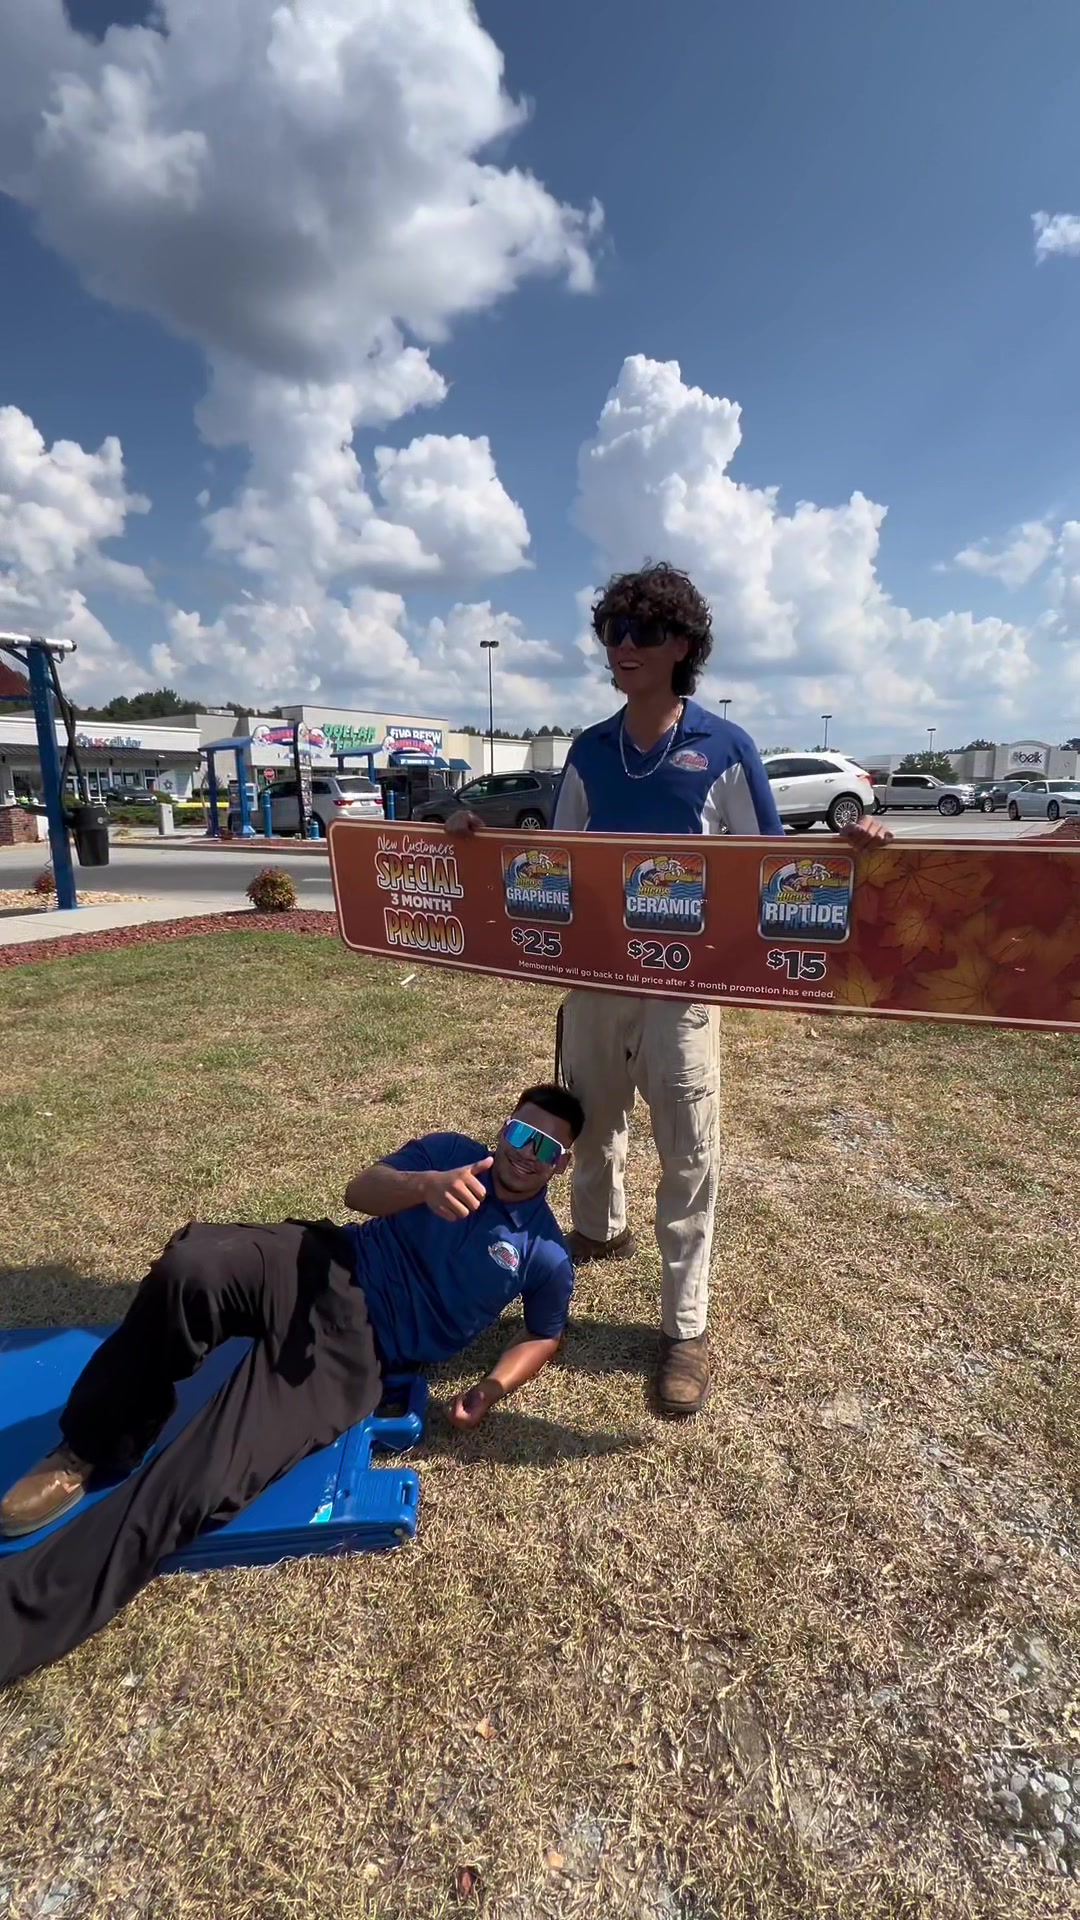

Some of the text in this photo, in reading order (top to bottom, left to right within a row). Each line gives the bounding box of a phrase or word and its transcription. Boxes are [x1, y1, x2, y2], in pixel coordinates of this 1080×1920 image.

[1019, 751, 1043, 763] belk
[377, 834, 455, 855] New Customers
[374, 850, 464, 898] SPECIAL
[391, 892, 452, 912] 3 MONTH
[506, 887, 570, 905] GRAPHENE
[627, 896, 702, 916] CERAMIC
[765, 902, 844, 925] RIPTIDE
[383, 907, 465, 955] PROMO
[511, 927, 562, 958] $25
[627, 939, 691, 971] $20
[766, 948, 827, 981] $15
[518, 960, 564, 974] Membership
[565, 967, 579, 975] will
[593, 971, 613, 979] back
[626, 974, 640, 982] full
[641, 976, 664, 984] price
[665, 978, 687, 986] after
[689, 979, 695, 987] 3
[697, 981, 727, 991] month
[729, 984, 780, 995] promotion
[782, 987, 799, 996] has
[801, 989, 836, 999] ended.
